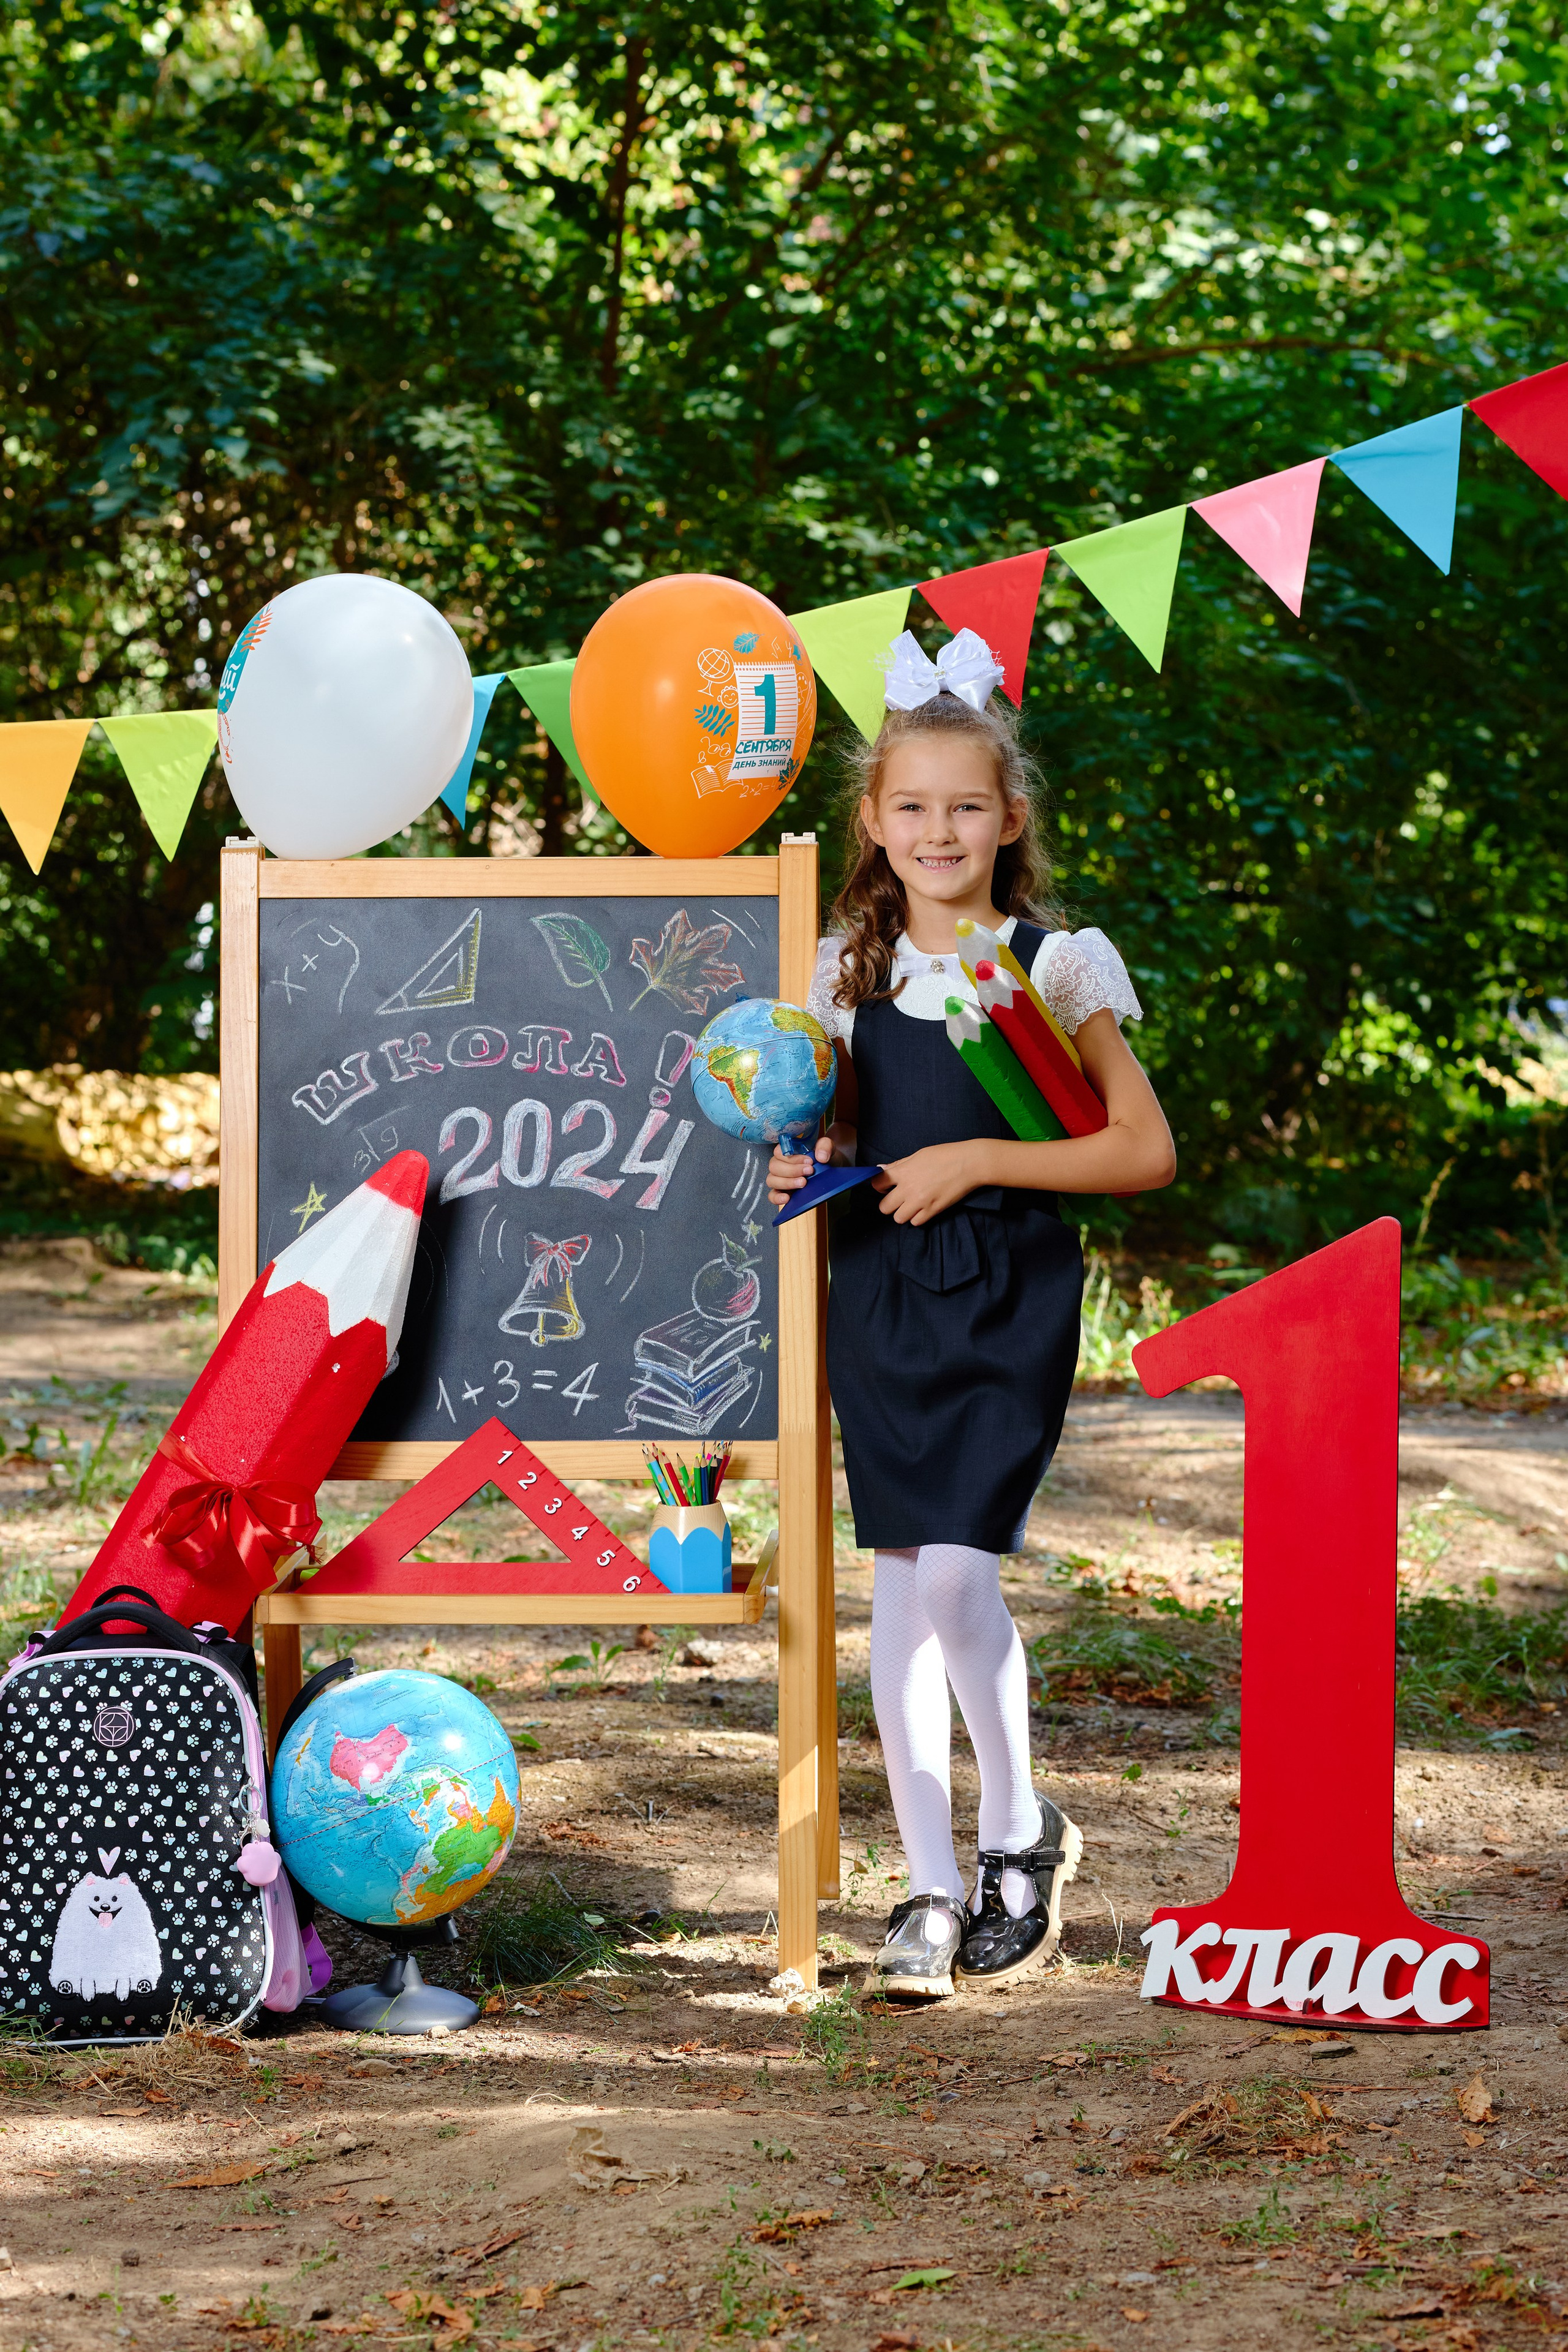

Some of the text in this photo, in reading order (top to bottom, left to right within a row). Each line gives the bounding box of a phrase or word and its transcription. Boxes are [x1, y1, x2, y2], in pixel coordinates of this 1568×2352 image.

[735, 739, 791, 754] СЕНТЯБРЯ
[754, 674, 776, 736] 1
[732, 757, 787, 771] ДЕНЬ ЗНАНИЙ
[438, 1098, 695, 1211] 2024
[497, 1450, 641, 1593] 1 2 3 4 5 6
[1131, 1216, 1491, 2031] 1
[1139, 1918, 1480, 2024] класс
